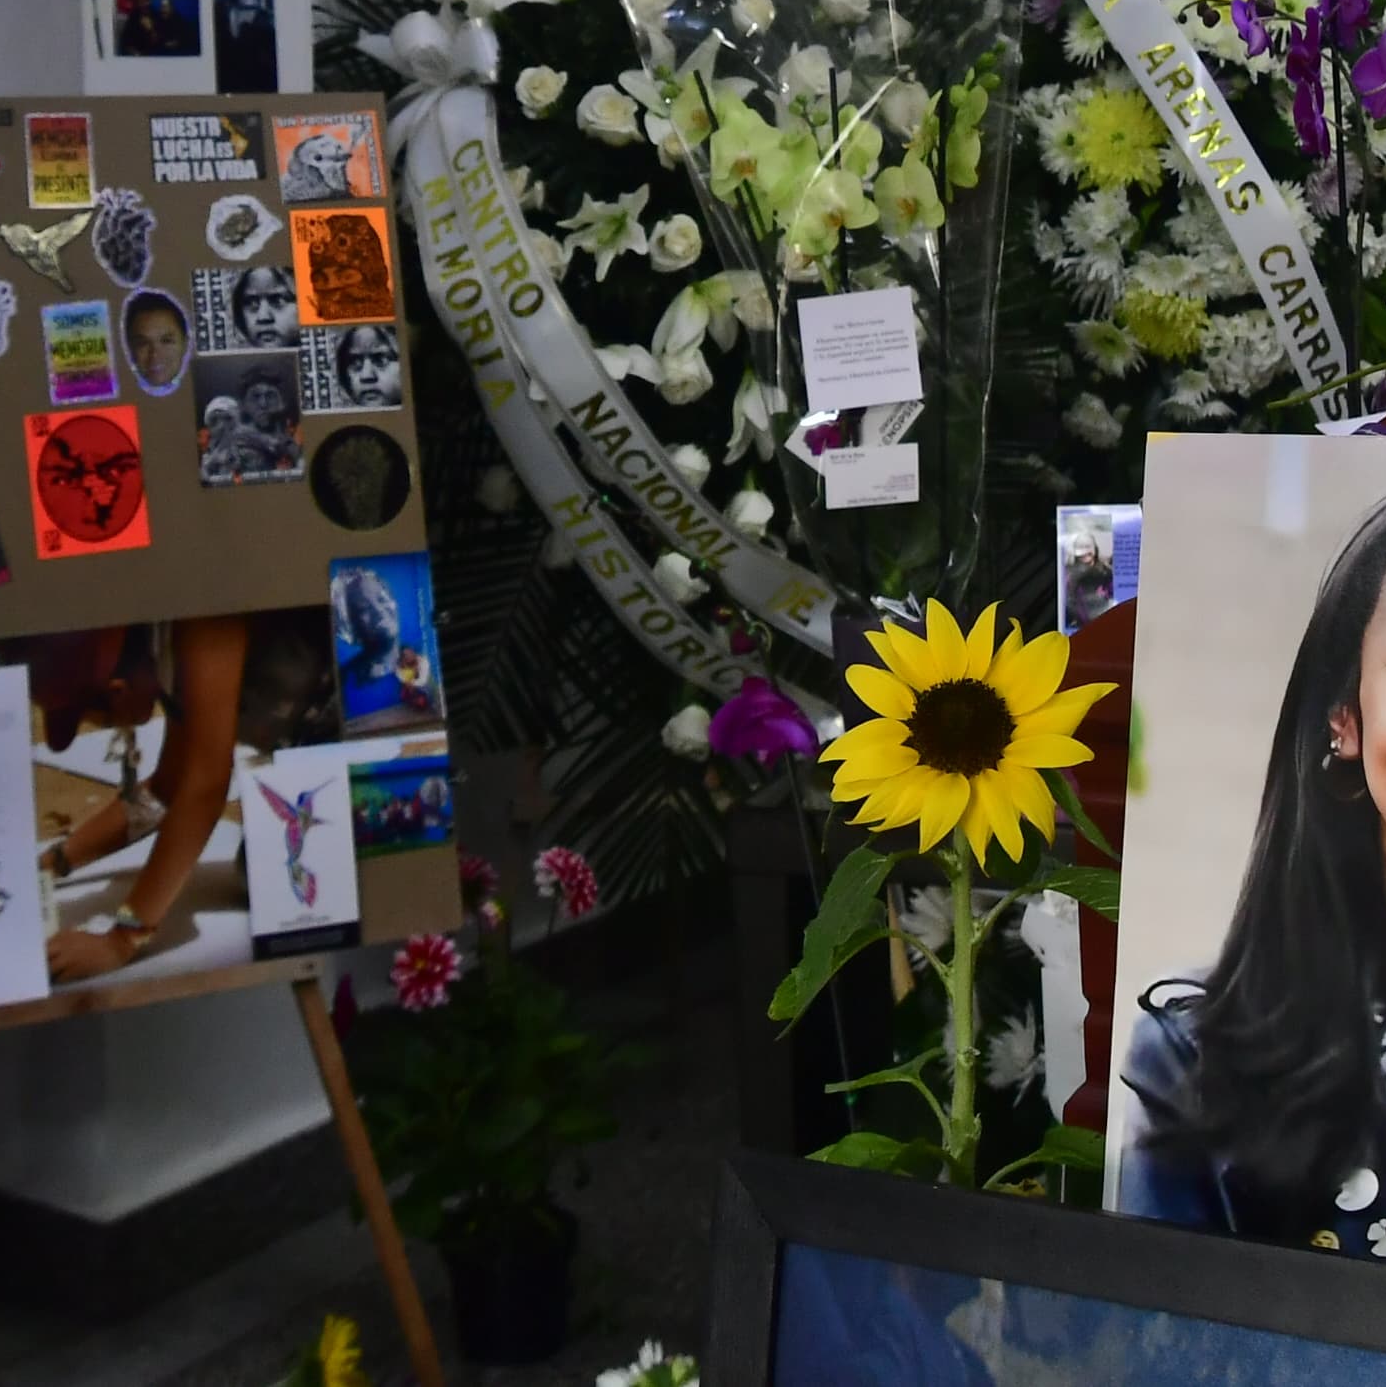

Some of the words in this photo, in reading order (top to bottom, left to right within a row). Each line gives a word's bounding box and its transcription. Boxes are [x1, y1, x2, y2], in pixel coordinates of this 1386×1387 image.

[152, 138, 215, 160] LUCHA
[192, 161, 214, 182] LA
[1138, 42, 1263, 216] ARENAS
[422, 172, 515, 410] MEMORIA
[451, 138, 544, 318] CENTRO
[571, 391, 742, 573] NACIONAL
